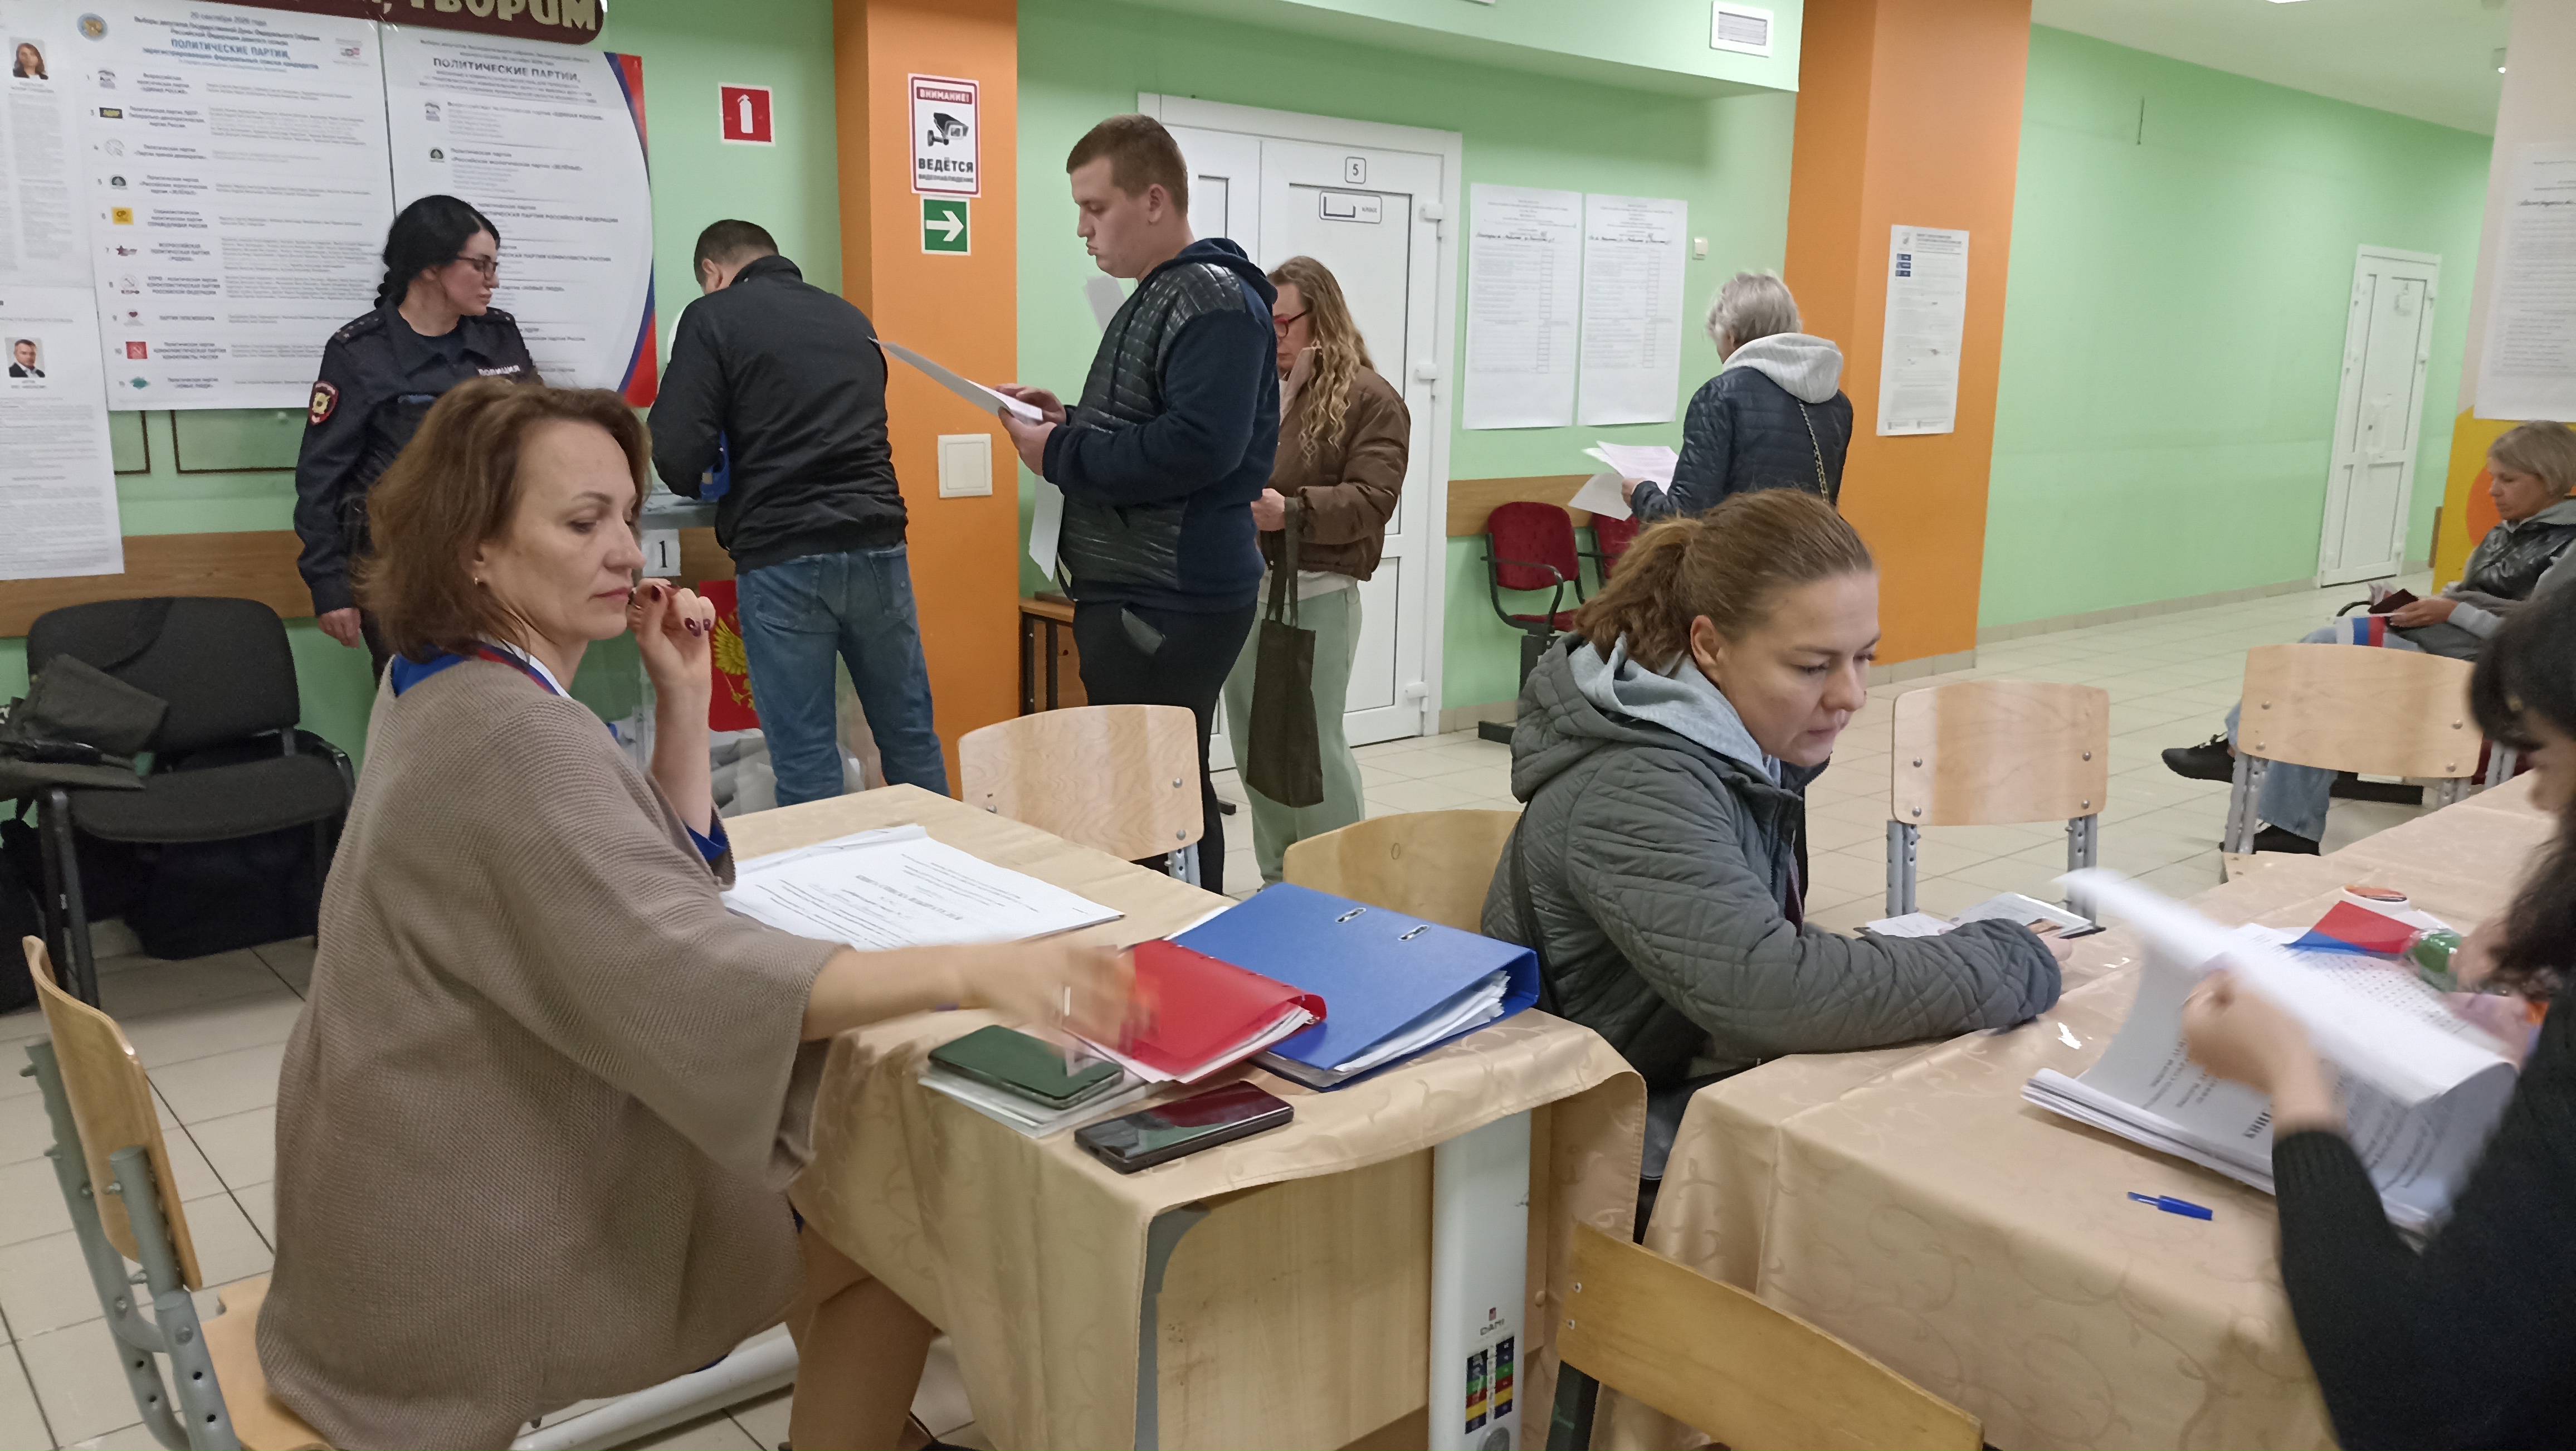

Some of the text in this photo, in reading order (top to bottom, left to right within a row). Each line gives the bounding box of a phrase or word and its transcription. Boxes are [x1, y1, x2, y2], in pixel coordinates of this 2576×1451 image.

[171, 38, 248, 56] ПОЛИТИЧЕСКИЕ
[433, 57, 581, 83] ПОЛИТИЧЕСКИЕ ПАРТИИ,
[920, 89, 970, 103] ВНИМАНИЕ!
[918, 157, 974, 173] ВЕДЁТСЯ
[1352, 163, 1359, 177] 5
[477, 364, 521, 377] ПОЛИЦИЯ
[658, 540, 668, 568] 1
